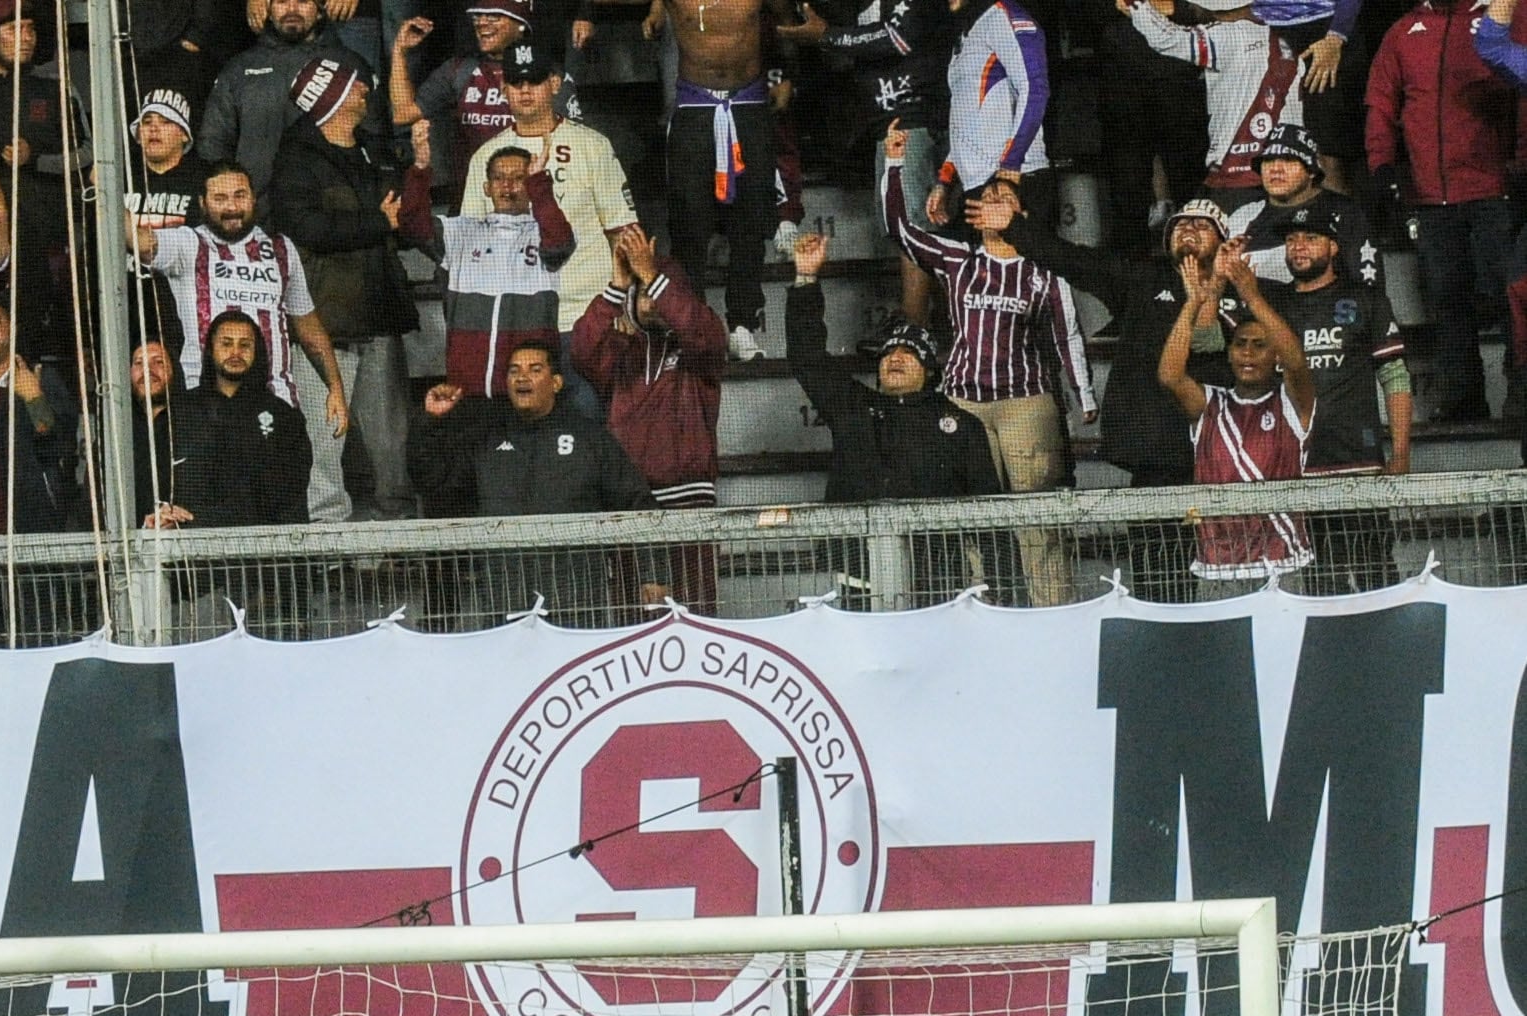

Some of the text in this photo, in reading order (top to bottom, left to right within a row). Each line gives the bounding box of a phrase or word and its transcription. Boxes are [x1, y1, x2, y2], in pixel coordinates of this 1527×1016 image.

[556, 145, 571, 163] S
[143, 193, 192, 215] MORE
[260, 240, 275, 259] S
[237, 266, 278, 283] BAC
[215, 289, 278, 304] LIBERTY
[1334, 298, 1358, 324] S
[1304, 327, 1343, 346] BAC
[557, 434, 574, 455] S
[488, 635, 855, 810] DEPORTIVO SAPRISSA
[576, 719, 763, 1006] S
